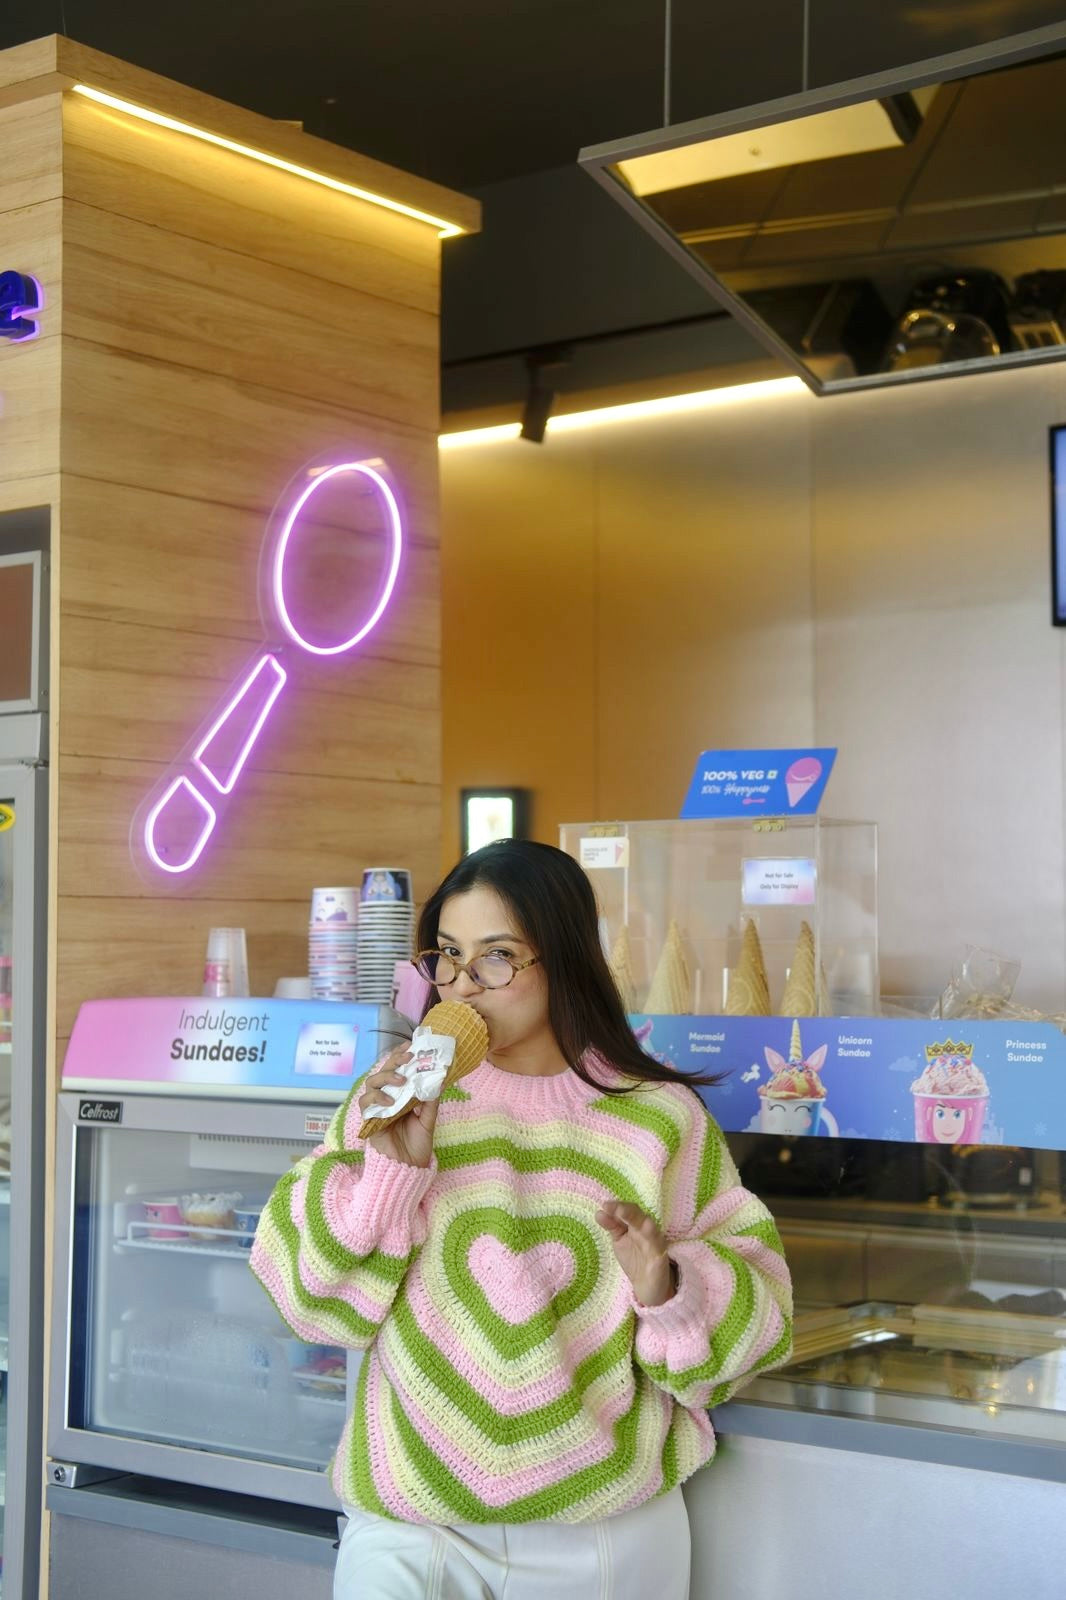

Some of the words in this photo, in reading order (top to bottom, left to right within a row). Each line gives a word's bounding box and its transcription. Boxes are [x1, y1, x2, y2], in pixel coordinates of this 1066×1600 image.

[703, 770, 738, 781] 100%
[741, 770, 765, 780] VEG
[178, 1008, 270, 1037] Indulgent
[838, 1035, 873, 1045] Unicorn
[1006, 1040, 1047, 1049] Princess
[170, 1038, 267, 1062] Sundaes!
[838, 1048, 871, 1057] Sundae
[1007, 1052, 1044, 1062] Sundae
[80, 1103, 119, 1119] Celfrost
